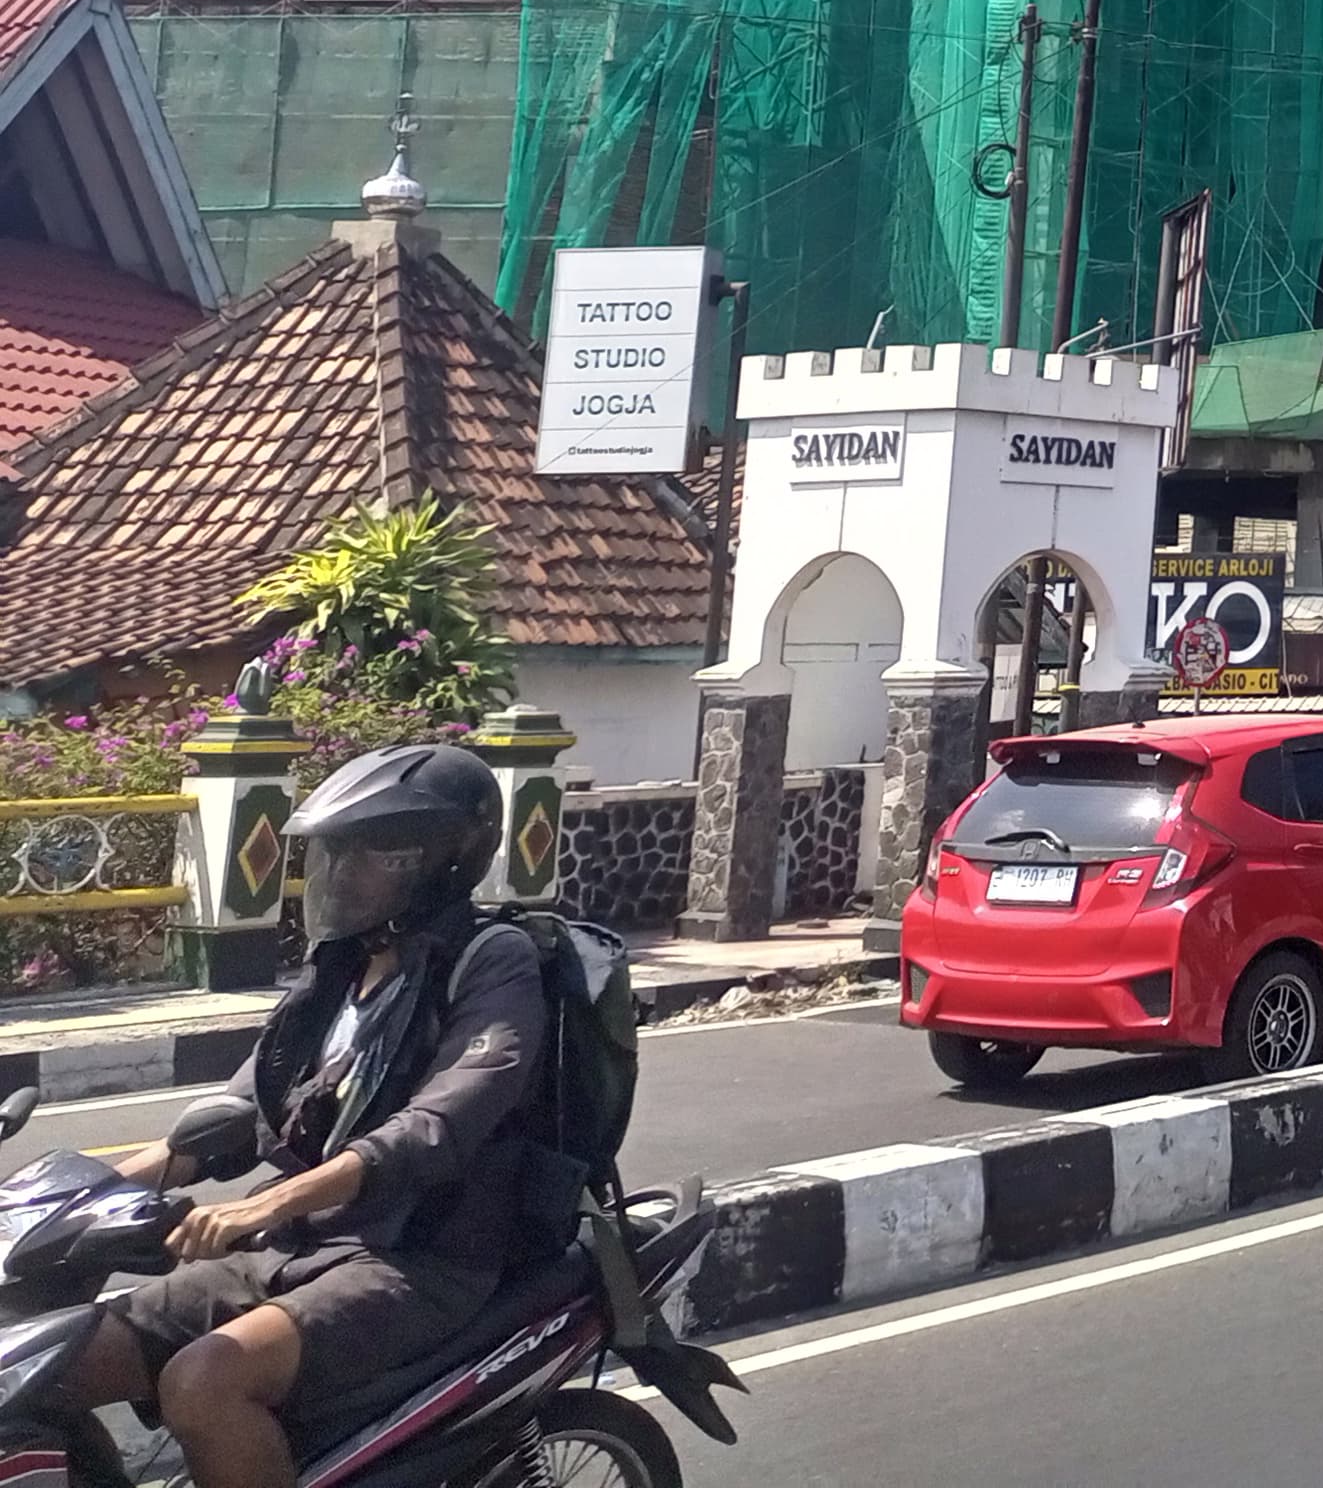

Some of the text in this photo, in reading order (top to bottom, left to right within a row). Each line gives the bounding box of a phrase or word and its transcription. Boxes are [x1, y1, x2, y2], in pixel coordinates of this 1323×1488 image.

[577, 301, 673, 323] TATTOO
[574, 347, 666, 369] STUDIO
[572, 394, 656, 416] JOGJA
[791, 430, 900, 464] SAYIDAN
[1009, 434, 1116, 469] SAYIDAN
[1218, 559, 1274, 576] ARLOJI
[475, 1312, 570, 1385] REVO
